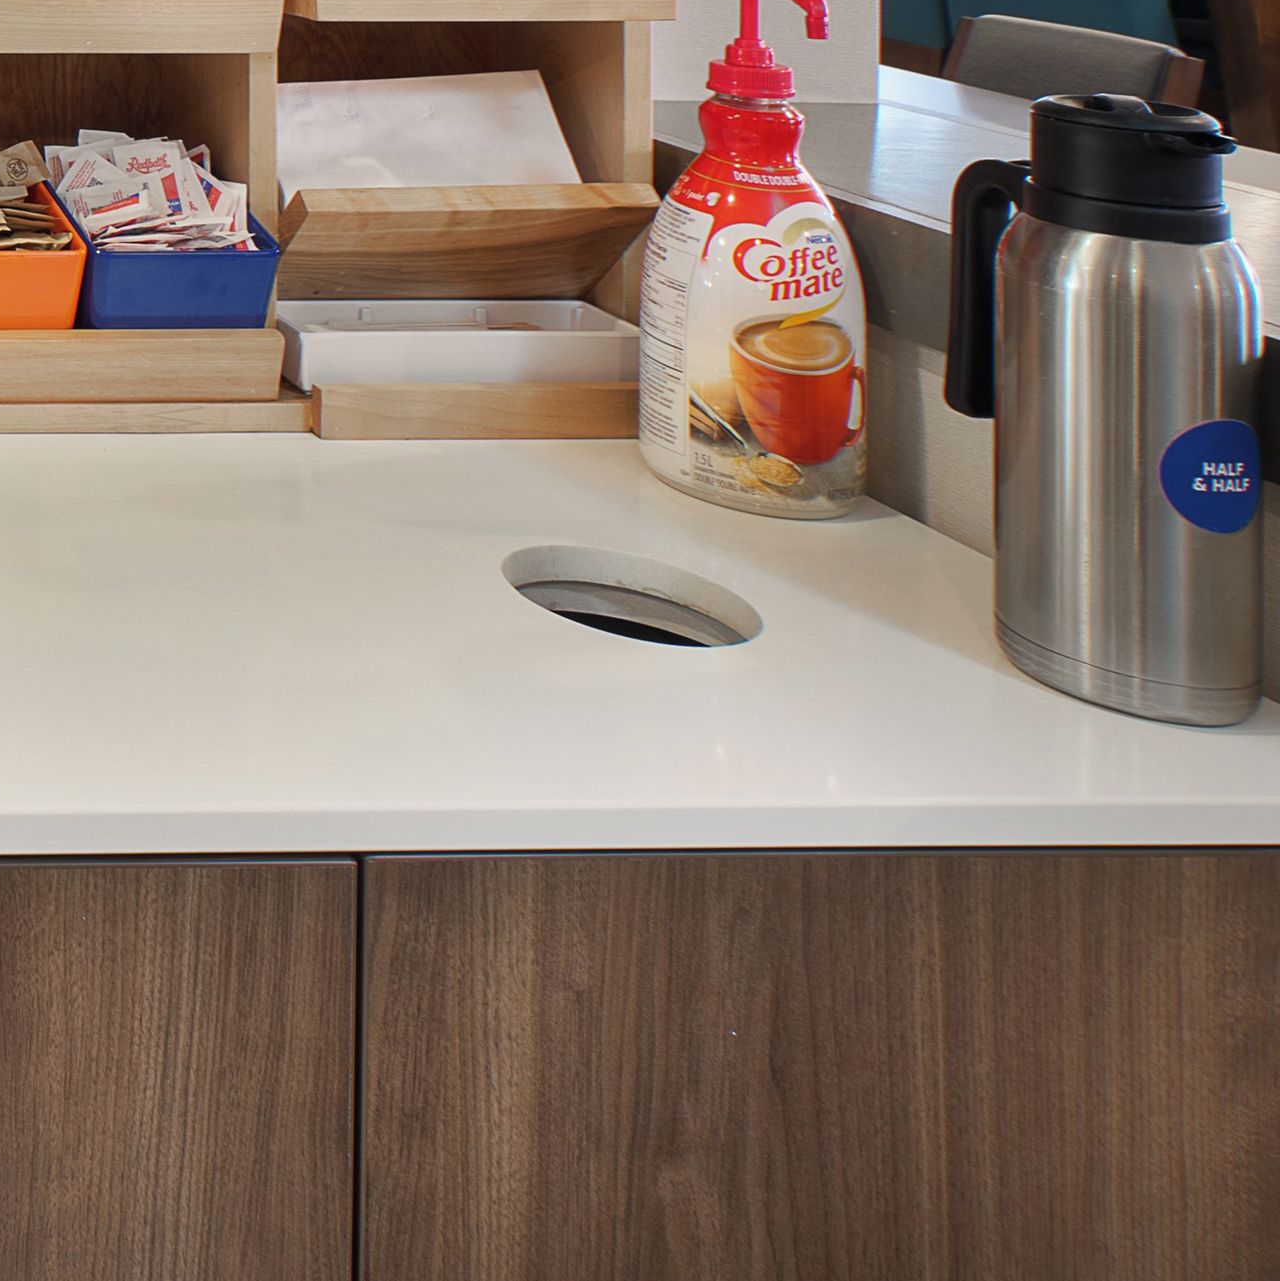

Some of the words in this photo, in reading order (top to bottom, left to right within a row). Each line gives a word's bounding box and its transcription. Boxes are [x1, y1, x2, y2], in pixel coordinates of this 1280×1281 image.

[732, 238, 838, 283] Coffee
[769, 267, 843, 301] mate
[1202, 462, 1244, 476] HALF
[1192, 477, 1207, 492] &
[1212, 478, 1250, 492] HALF
